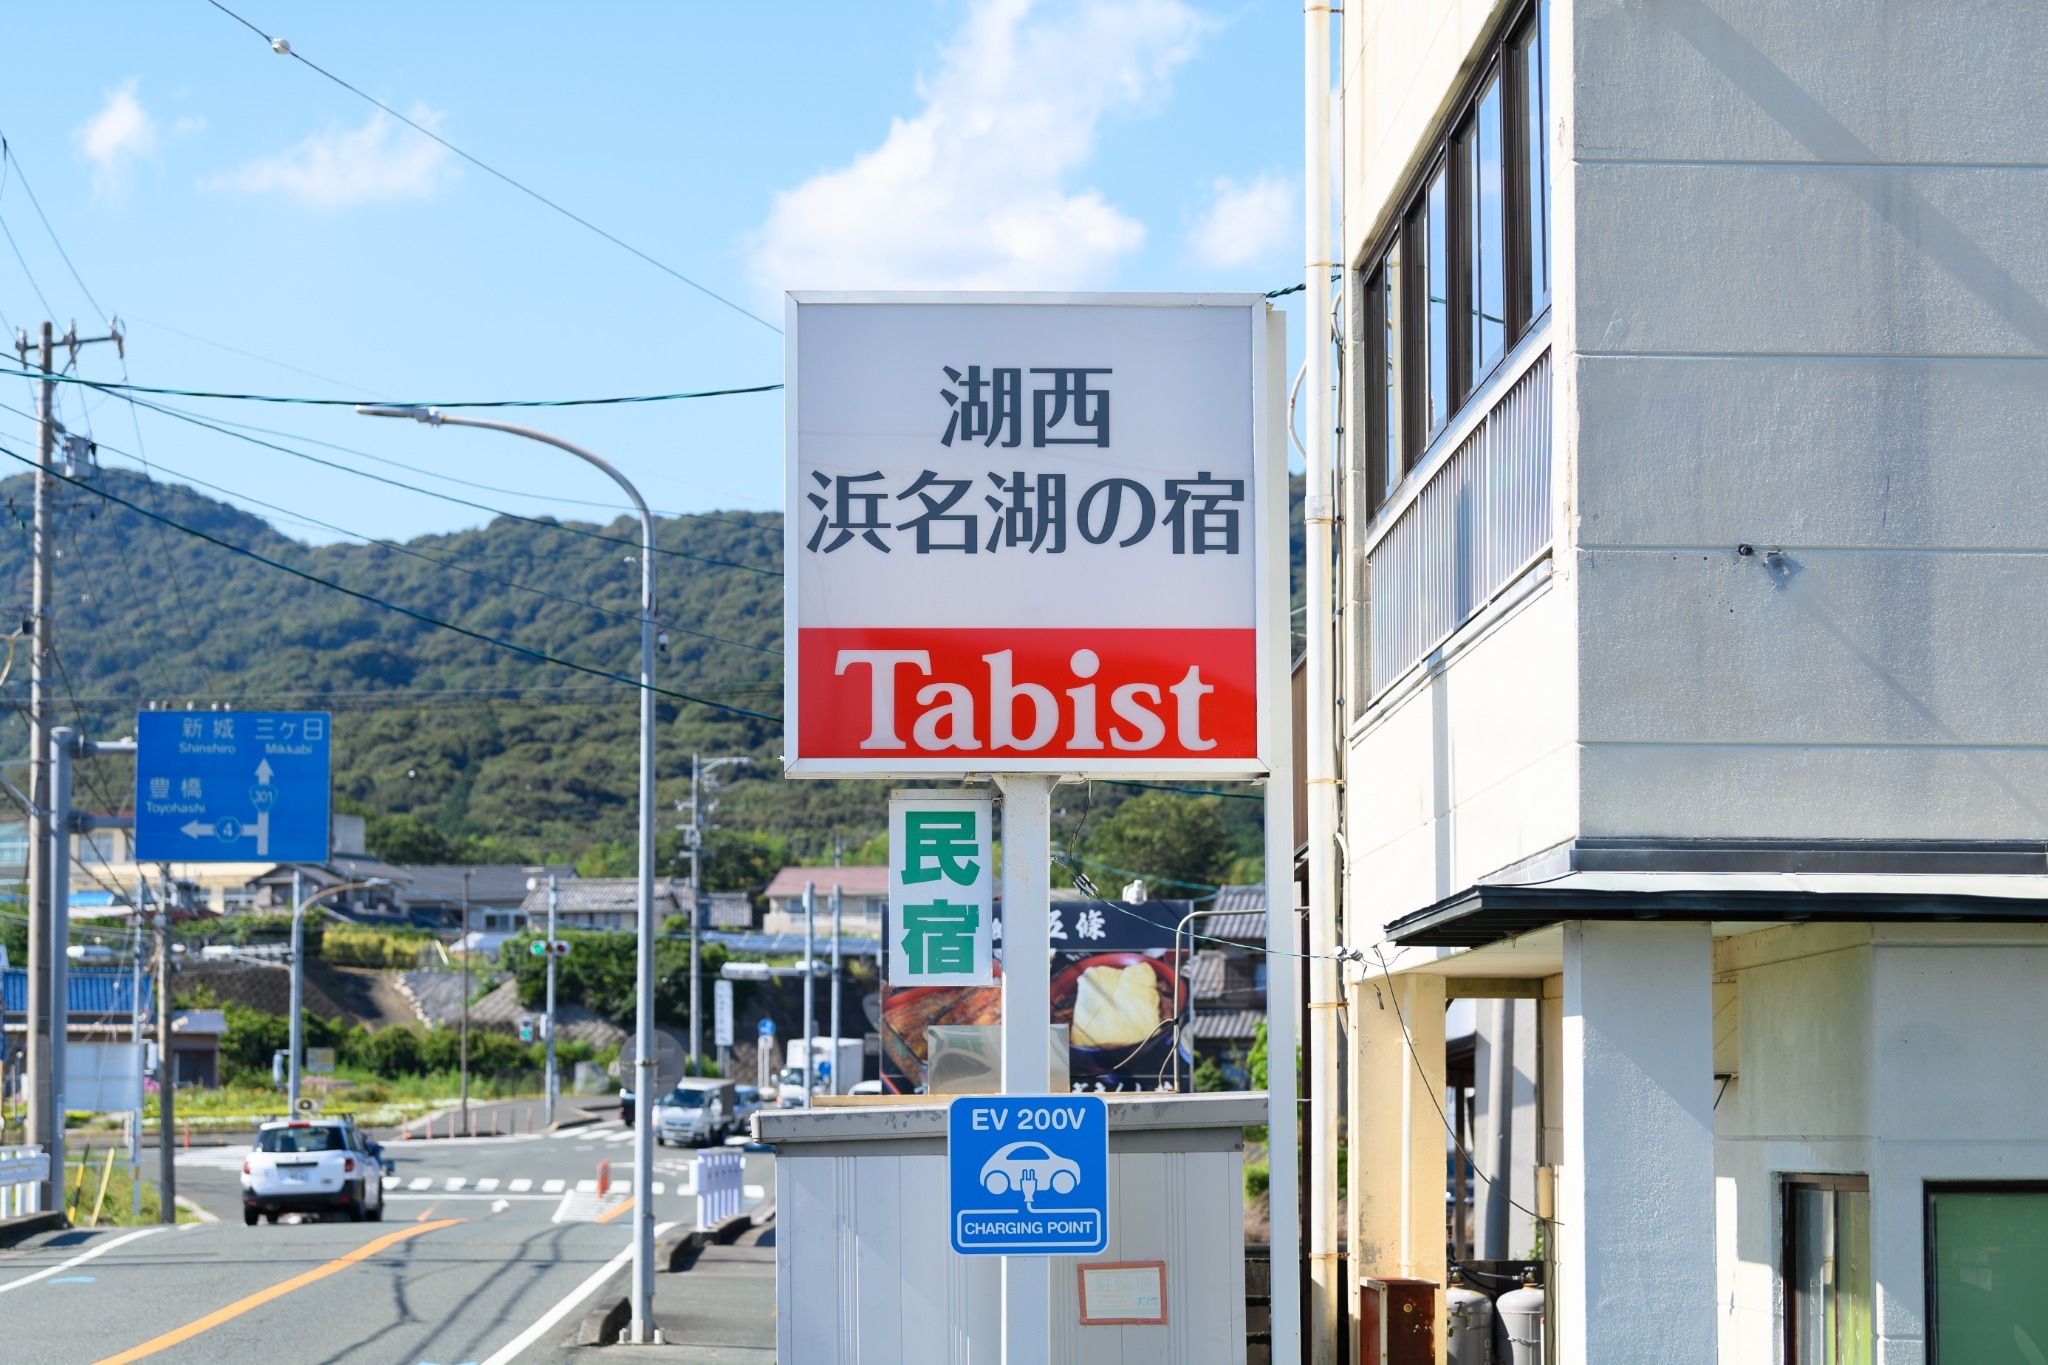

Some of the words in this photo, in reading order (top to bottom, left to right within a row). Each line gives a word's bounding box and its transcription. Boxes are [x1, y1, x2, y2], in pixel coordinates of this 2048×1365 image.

[940, 365, 1113, 448] 湖西
[806, 469, 1245, 554] 浜名湖の宿
[834, 648, 1218, 751] Tabist
[182, 717, 235, 740] 新城
[179, 742, 236, 754] Shinshiro
[265, 743, 312, 755] Mikkabi
[150, 777, 202, 799] 豊橋
[254, 791, 273, 803] 301
[146, 801, 206, 815] Toyohashi
[222, 823, 233, 837] 4
[900, 811, 981, 975] 民宿
[972, 1108, 1008, 1130] EV
[1017, 1108, 1086, 1130] 200V
[964, 1222, 1043, 1235] CHARGING
[1047, 1221, 1094, 1234] POINT
